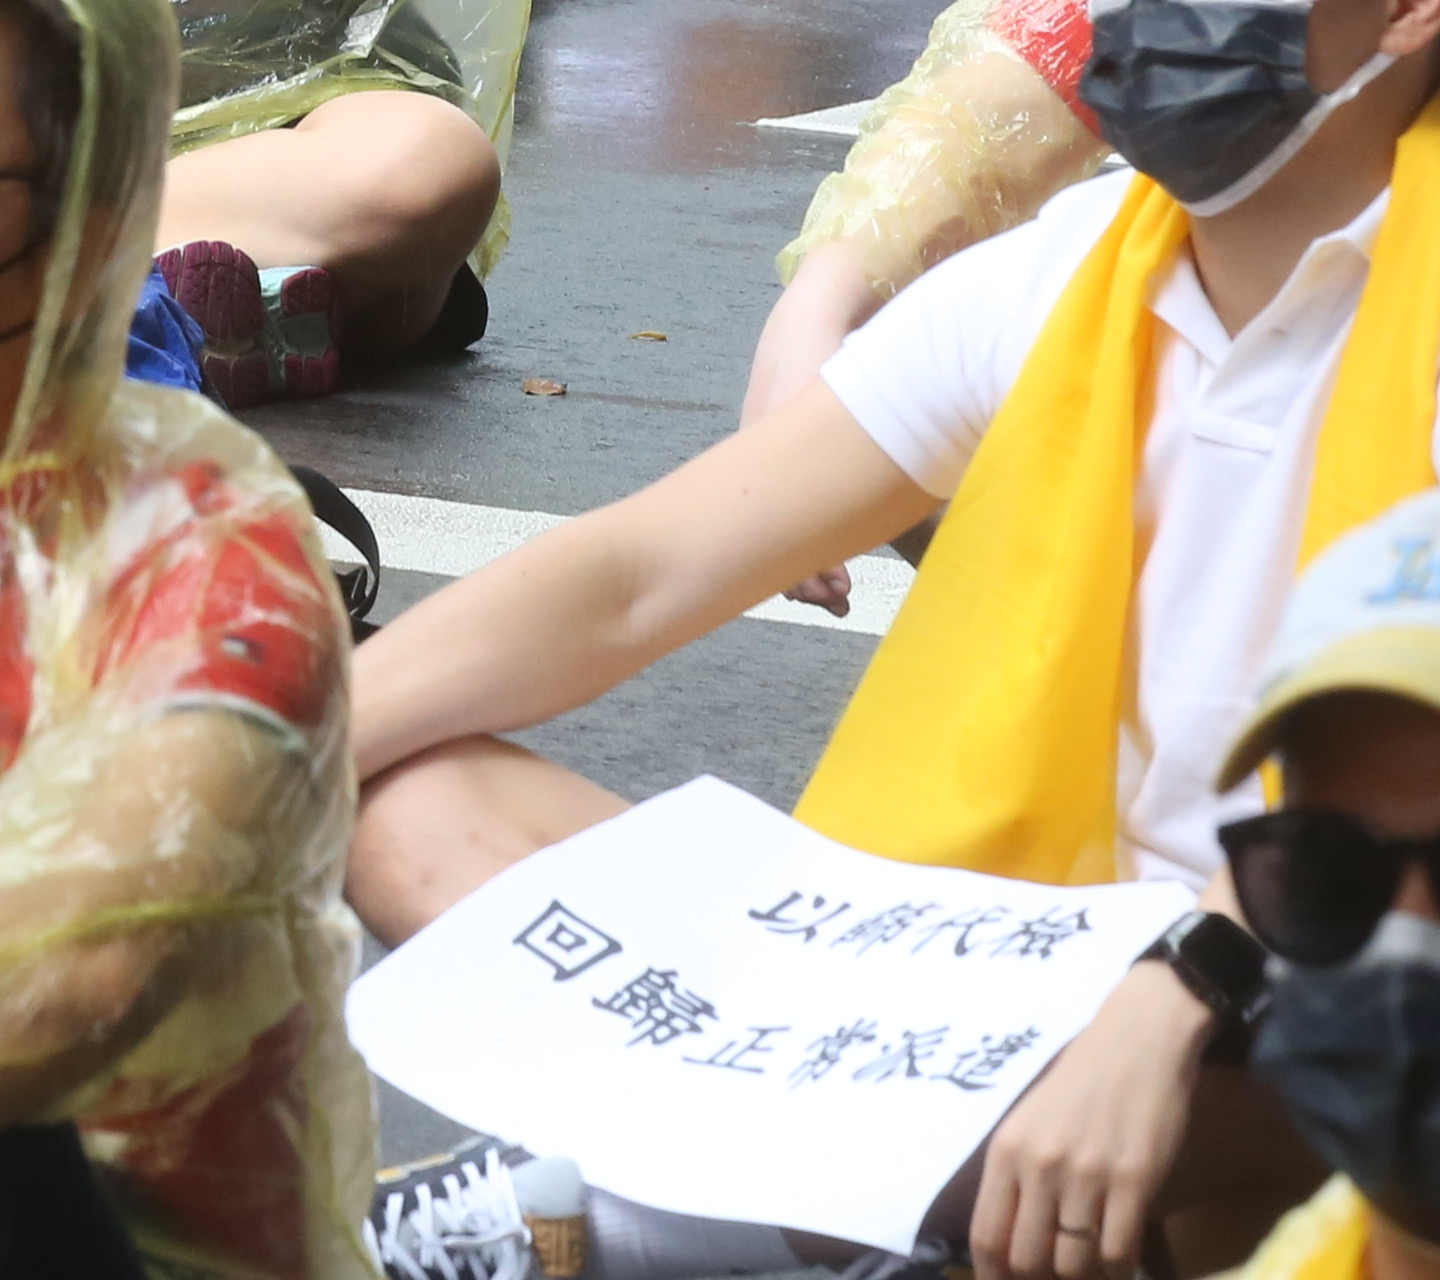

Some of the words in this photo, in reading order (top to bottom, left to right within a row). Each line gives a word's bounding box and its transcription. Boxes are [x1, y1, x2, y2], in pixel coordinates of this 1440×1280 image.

[748, 889, 1093, 960] 以篩代檢
[514, 900, 1039, 1092] 回歸正常派遣
